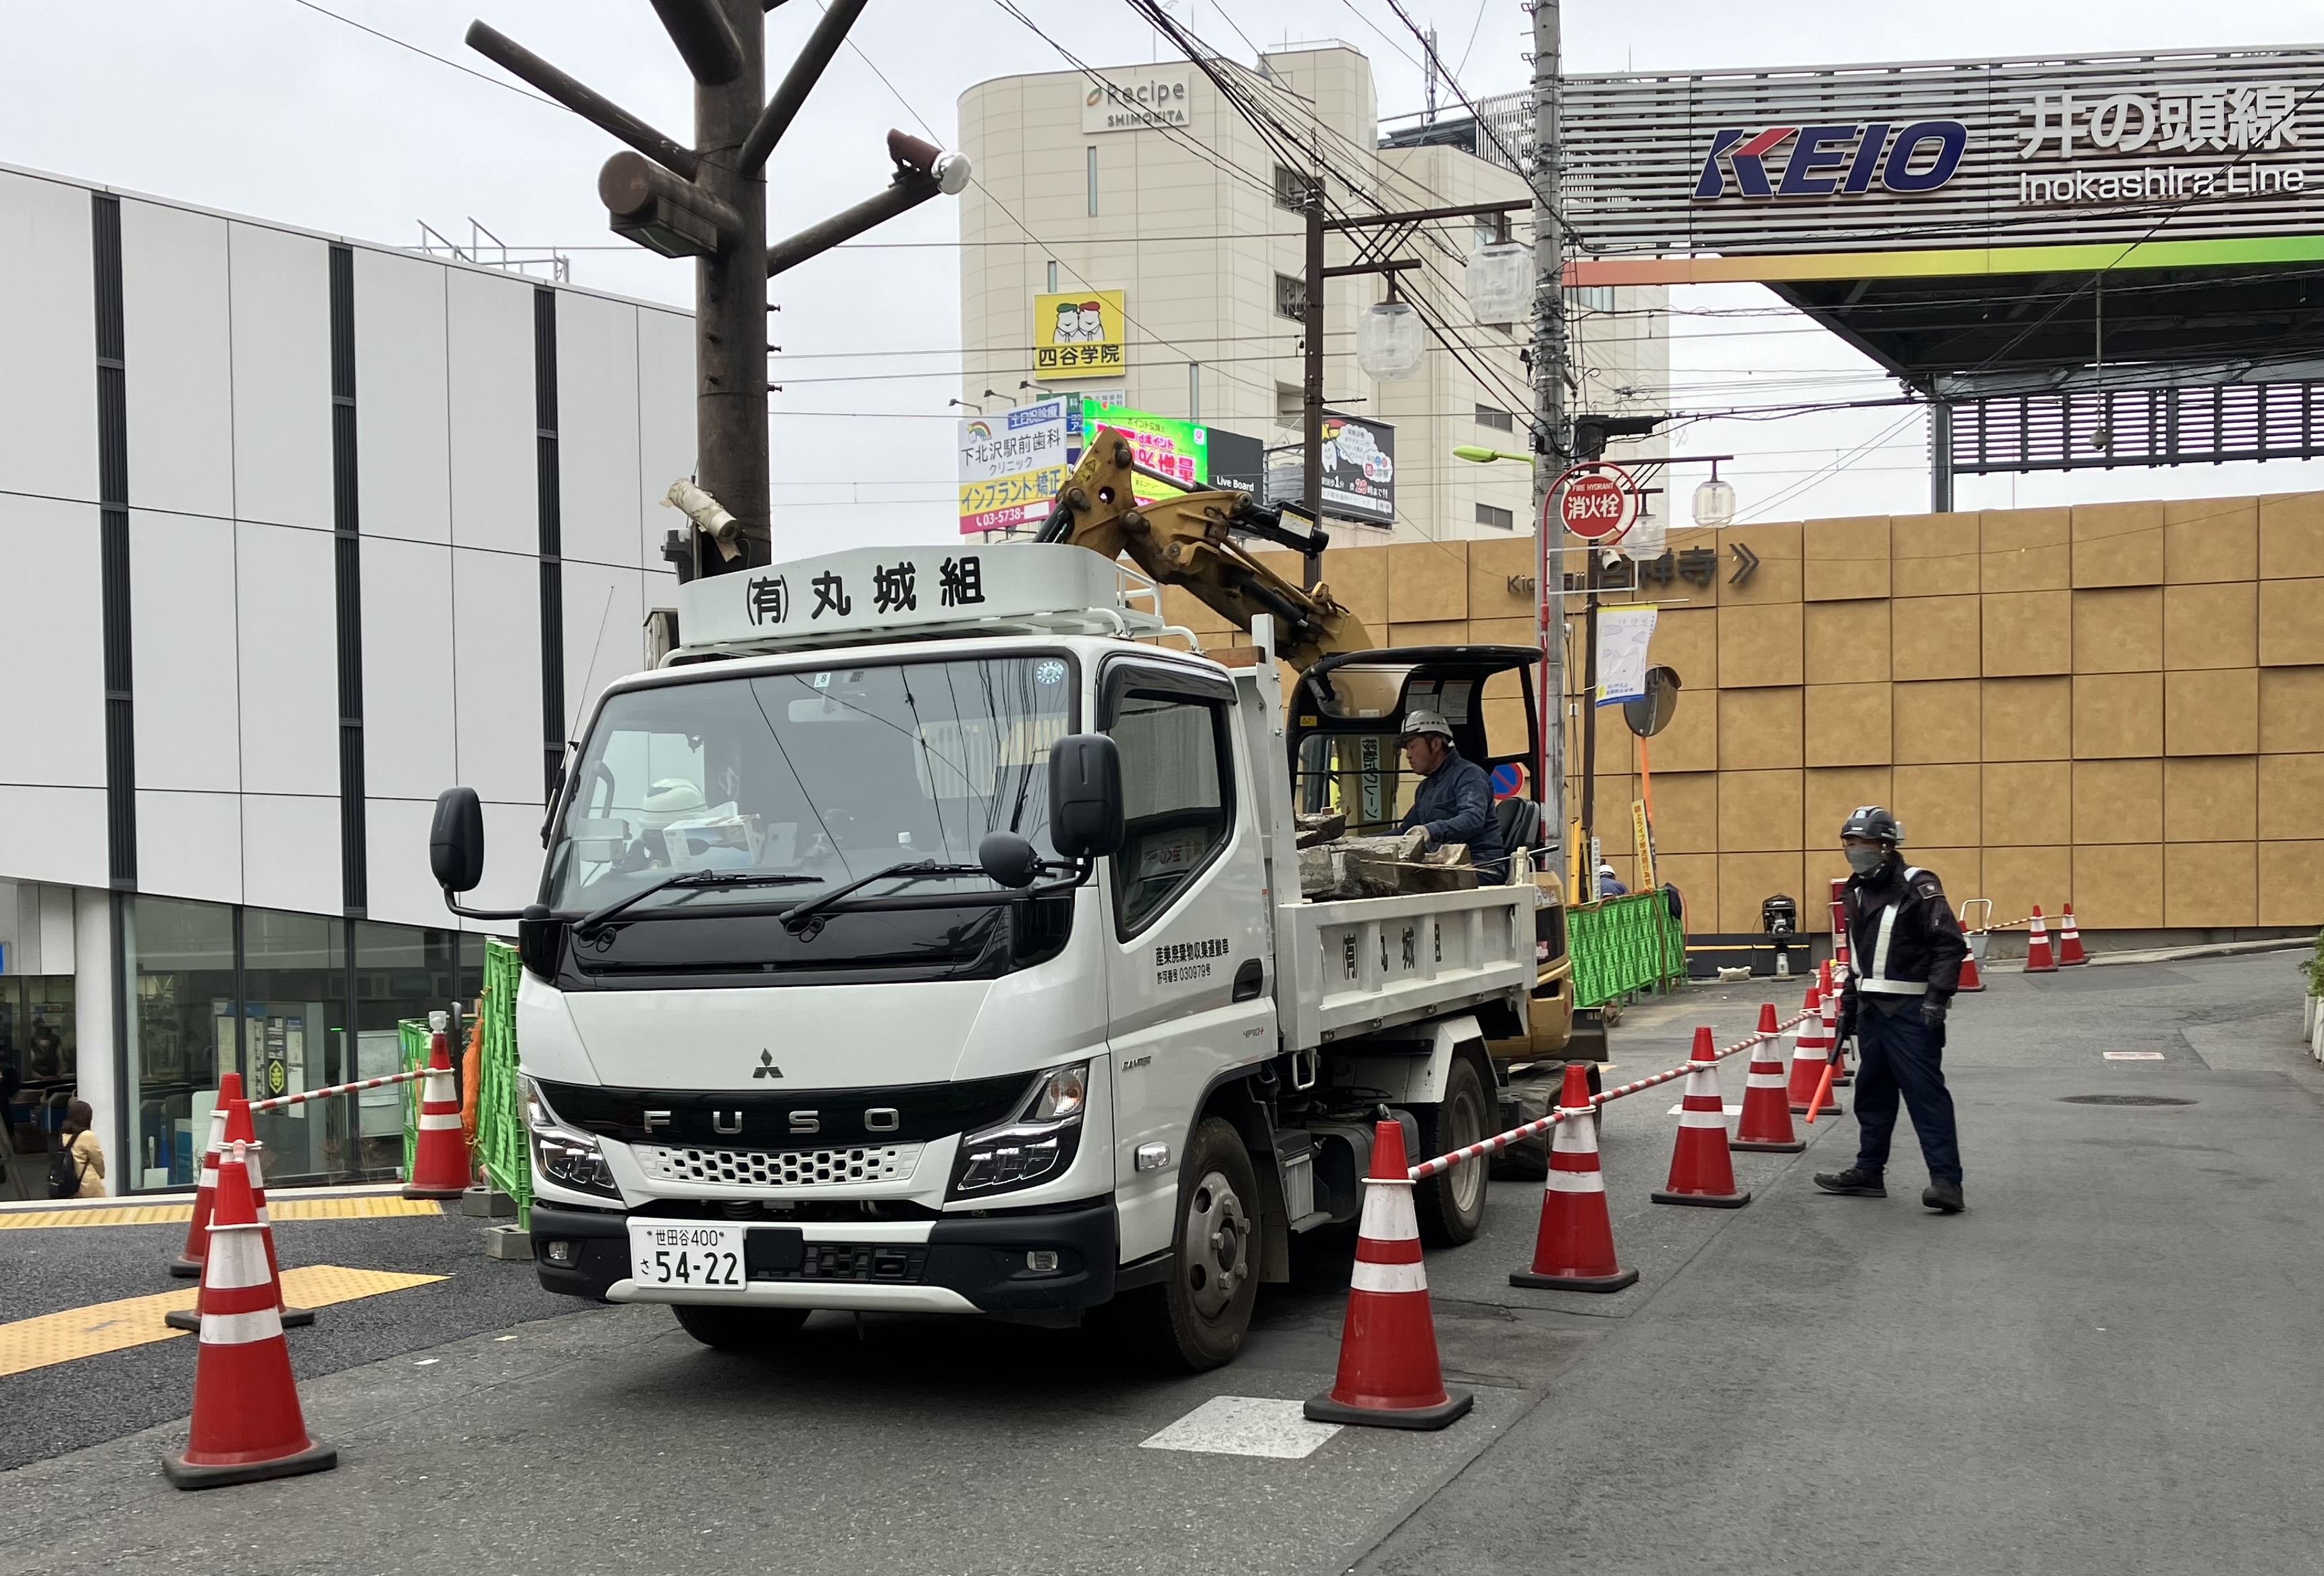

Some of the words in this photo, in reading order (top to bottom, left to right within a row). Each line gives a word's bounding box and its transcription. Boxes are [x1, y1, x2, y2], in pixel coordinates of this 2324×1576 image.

[1107, 80, 1185, 107] Recipe
[1107, 109, 1185, 127] SHIMOKITA
[2018, 84, 2299, 159] 井の頭線
[1693, 120, 1968, 199] KEIO
[2021, 166, 2215, 204] Inokashira
[2229, 163, 2304, 192] Line
[1039, 344, 1120, 367] 四谷学院
[1011, 404, 1058, 428] 土日祝診療
[961, 427, 1061, 467] 下北沢駅前歯科
[989, 456, 1032, 476] クリニック
[1217, 476, 1232, 488] Live
[1233, 479, 1255, 492] Board
[1572, 484, 1585, 492] FIRE
[1587, 482, 1614, 491] HYDRANT
[1567, 493, 1620, 520] 消火栓
[643, 1107, 899, 1134] FUSO
[640, 1259, 650, 1276] さ
[656, 1251, 739, 1285] 54-22
